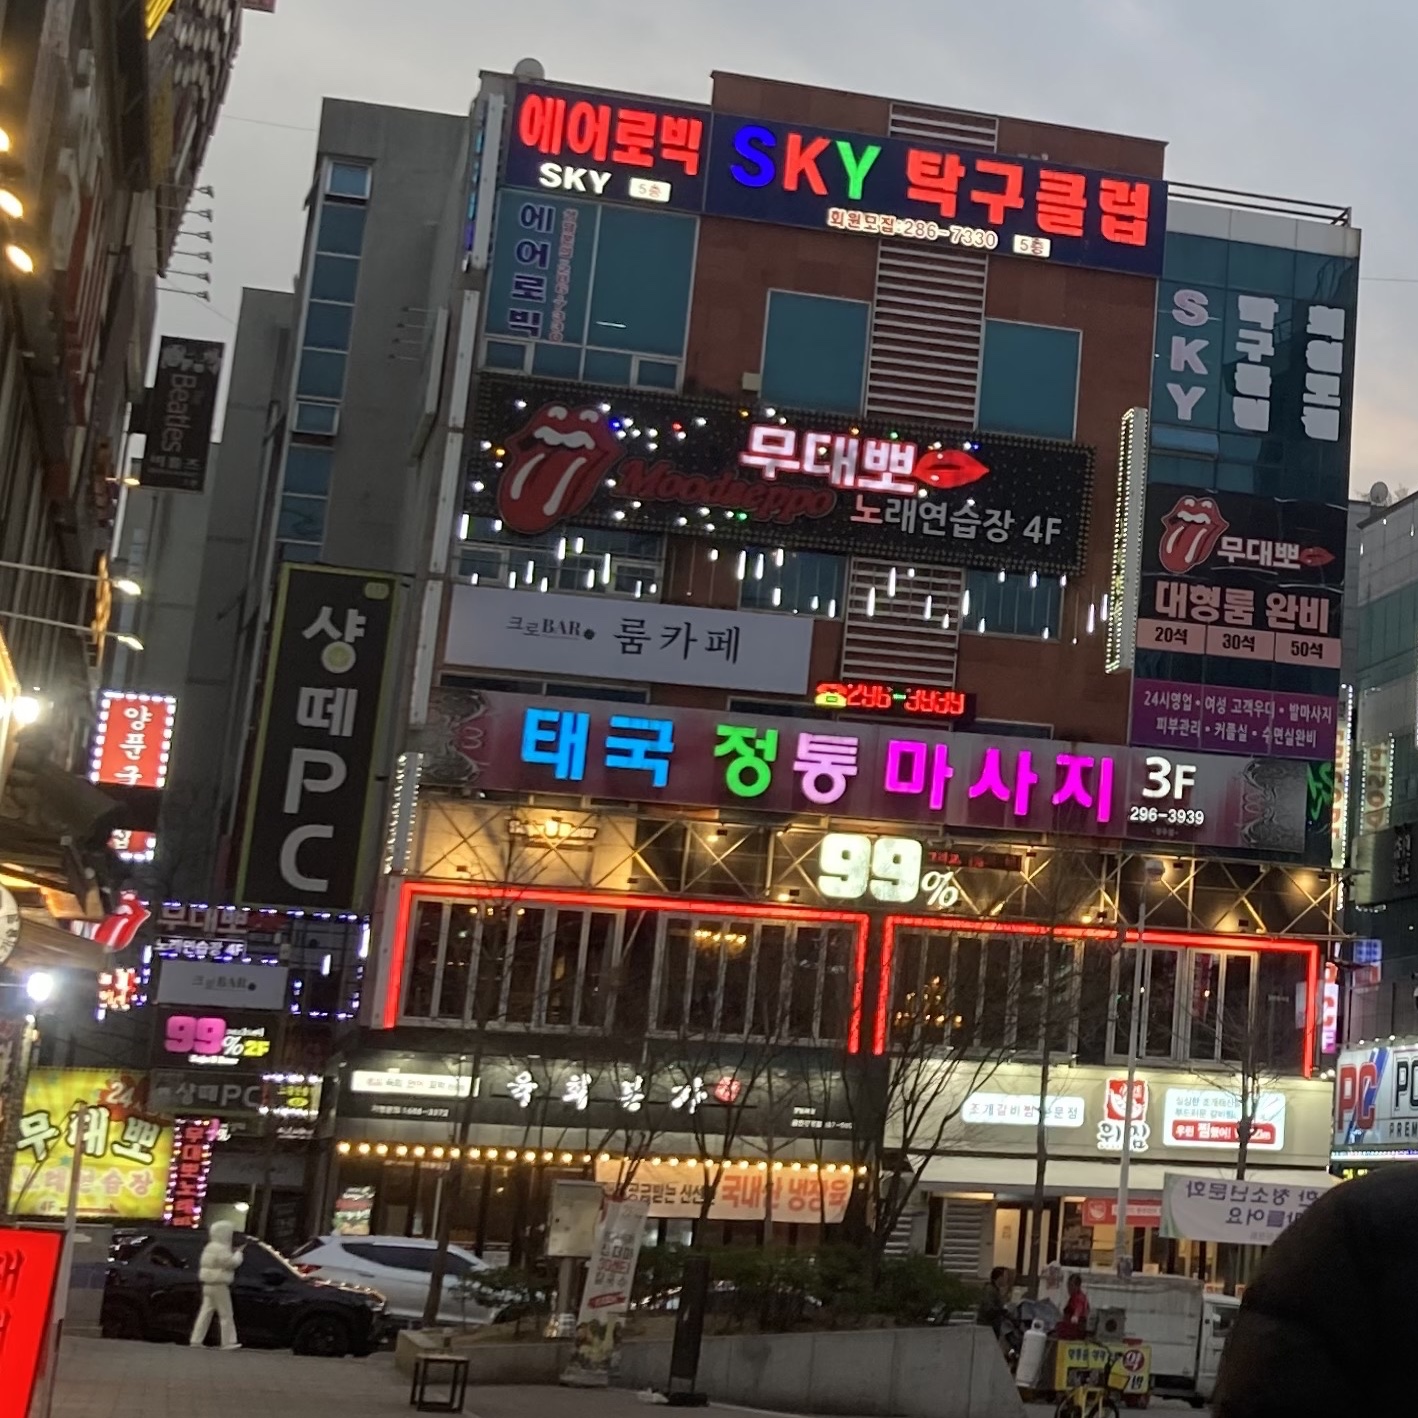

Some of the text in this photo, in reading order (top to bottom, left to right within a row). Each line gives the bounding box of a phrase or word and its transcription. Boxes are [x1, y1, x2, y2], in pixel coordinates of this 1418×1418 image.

[519, 94, 702, 175] 에어로빅
[539, 162, 612, 195] SKY
[731, 125, 1150, 246] SKY 탁구클럽
[508, 204, 556, 338] 에어로빅
[1019, 239, 1045, 255] 5층
[1166, 289, 1209, 420] SKY
[738, 424, 918, 495] 무대뽀
[850, 495, 1062, 545] 노래연습장 4F
[1217, 536, 1301, 570] 무대뽀
[1155, 580, 1329, 633] 대형룸 완비
[613, 617, 741, 665] 룸카페
[1155, 626, 1323, 659] 20석 30석 50석
[1144, 691, 1193, 713] 24시영업
[1204, 695, 1227, 715] 여성
[1289, 702, 1333, 723] 발마사지
[1155, 717, 1201, 738] 피부관리
[1214, 721, 1248, 743] 커플실
[521, 707, 1114, 824] 태국 정통 마사지
[1142, 756, 1197, 799] 3F
[1130, 806, 1204, 825] 296-3939
[243, 1041, 270, 1057] 2F
[1337, 1062, 1378, 1132] PC
[17, 1105, 161, 1165] 무대뽀
